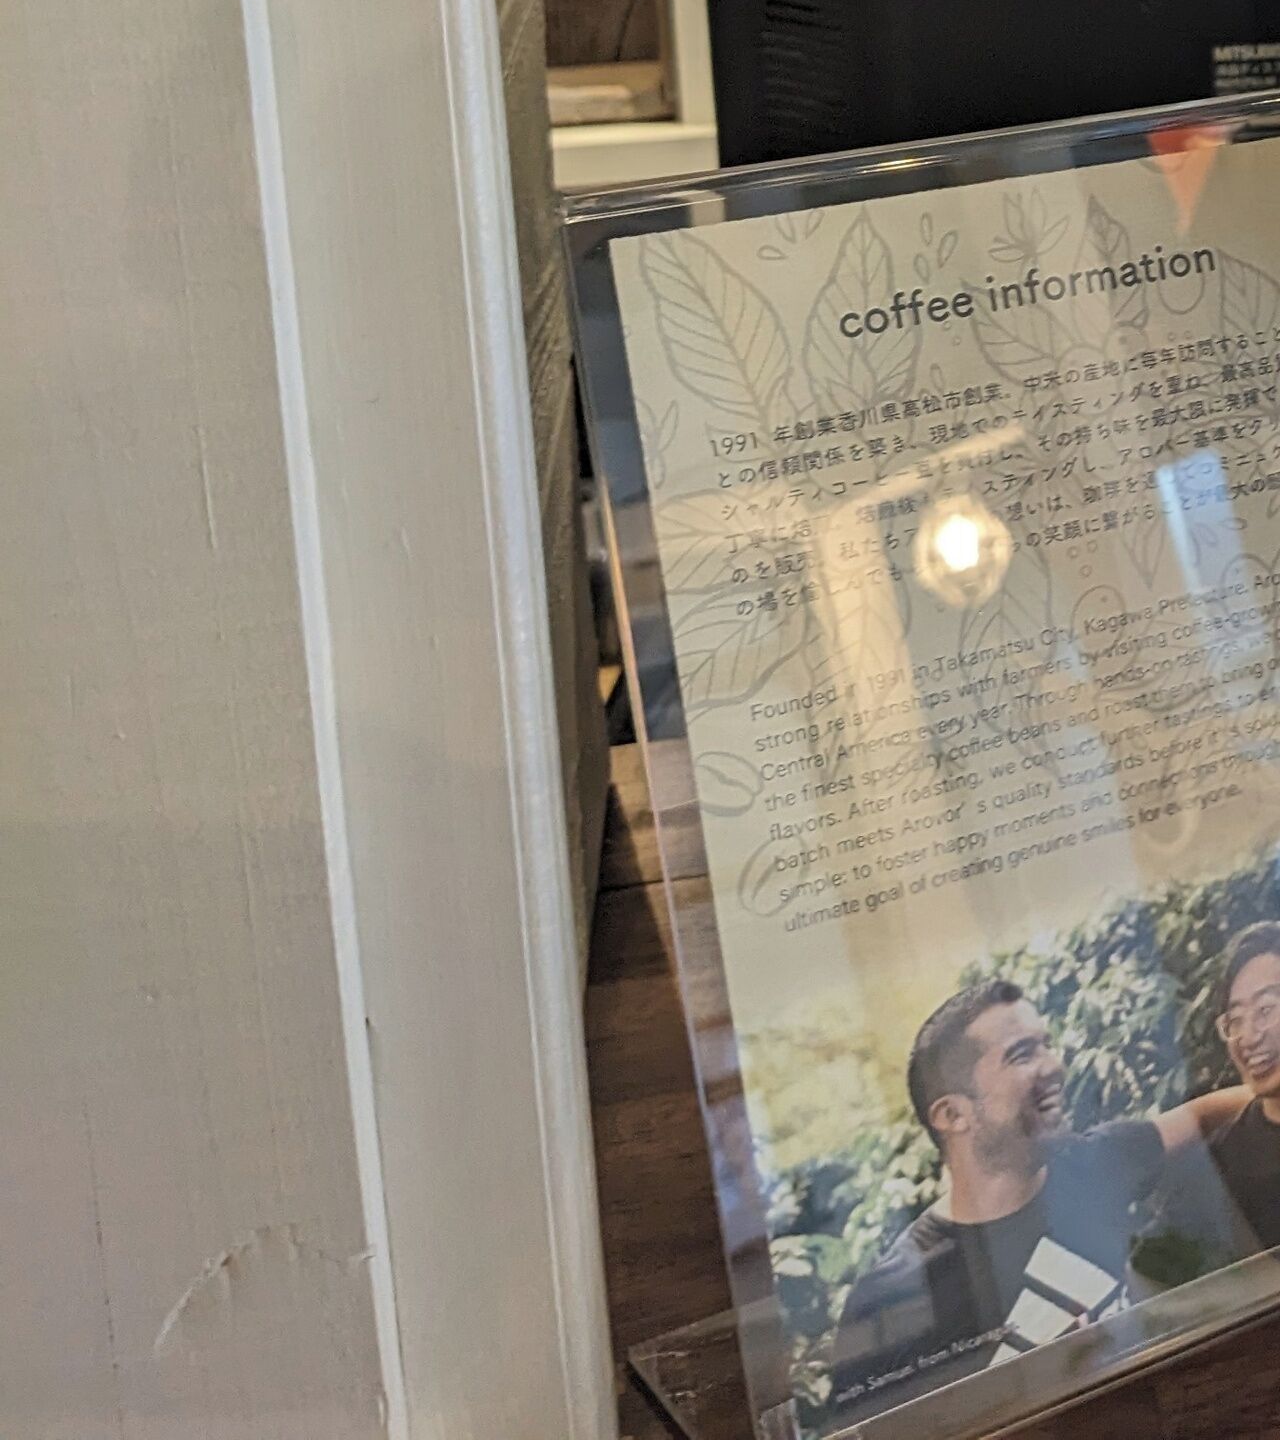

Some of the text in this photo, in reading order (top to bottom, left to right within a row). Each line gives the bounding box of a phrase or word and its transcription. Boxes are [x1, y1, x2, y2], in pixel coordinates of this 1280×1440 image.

[839, 245, 1216, 339] coffee information
[708, 429, 760, 459] 1991
[749, 682, 837, 720] Founded
[933, 634, 1034, 672] Takamatsu
[1083, 604, 1152, 633] Kagawa
[754, 721, 820, 750] strong
[825, 686, 951, 731] relationships
[956, 670, 997, 696] with
[1001, 654, 1072, 684] farmers
[758, 746, 829, 780] Central
[834, 727, 912, 759] America
[917, 712, 966, 737] every
[1013, 676, 1086, 710] Through
[762, 789, 796, 811] the
[800, 770, 854, 800] finest
[947, 732, 1003, 759] coffee
[1006, 716, 1061, 743] beans
[1066, 702, 1099, 726] and
[1103, 689, 1147, 716] roast
[768, 809, 841, 841] flavors.
[845, 793, 894, 819] After
[1020, 732, 1098, 769] conduct
[773, 839, 830, 871] batch
[835, 823, 894, 853] meets
[991, 778, 1053, 811] quality
[1056, 751, 1143, 788] standards
[1147, 735, 1202, 762] before
[778, 868, 848, 901] simple:
[874, 844, 928, 872] foster
[932, 827, 988, 855] happy
[992, 800, 1076, 837] moments
[1079, 787, 1112, 811] and
[783, 895, 860, 931] ultimate
[864, 879, 904, 911] goal
[930, 853, 1003, 886] creating
[1006, 830, 1077, 867] genuine
[1081, 813, 1136, 840] smiles
[1137, 805, 1161, 823] for
